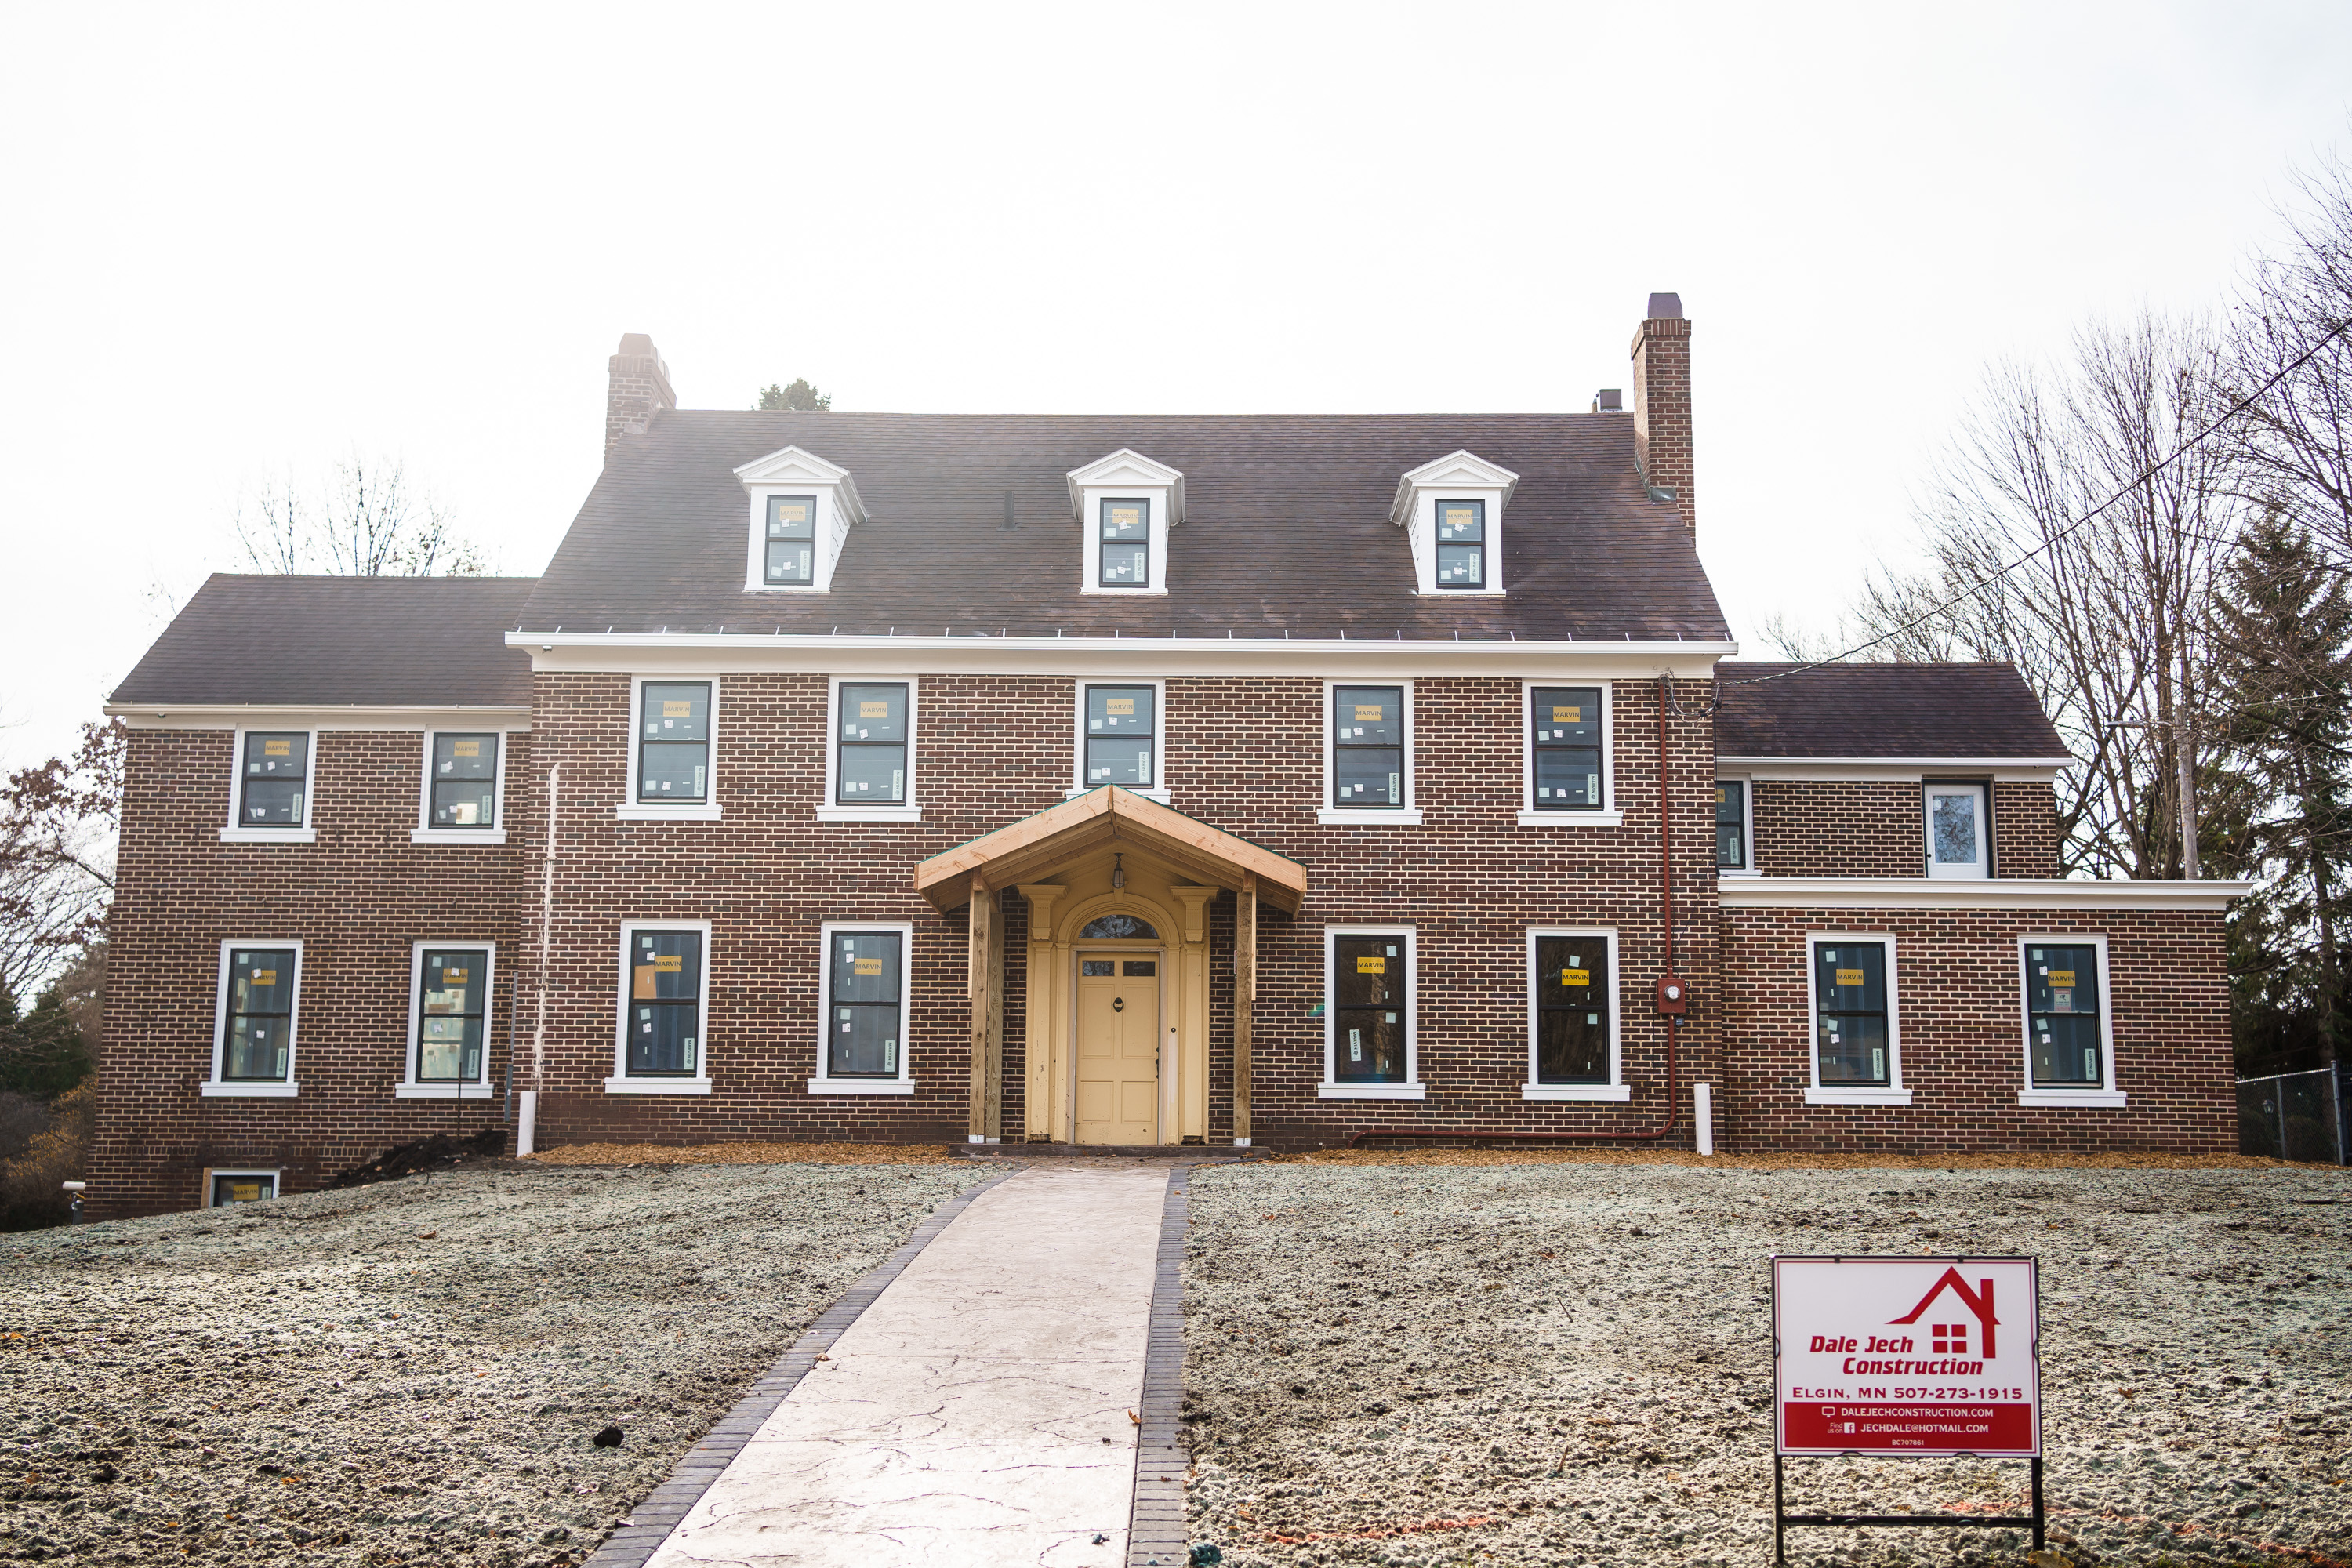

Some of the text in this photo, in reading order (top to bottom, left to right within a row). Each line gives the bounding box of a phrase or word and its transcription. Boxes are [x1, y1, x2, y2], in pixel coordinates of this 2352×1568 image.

[1810, 1336, 1914, 1353] Dale Jech
[1843, 1358, 1983, 1375] Construction
[1858, 1388, 1886, 1399] MN
[1894, 1388, 2022, 1399] 507-273-1915
[1841, 1408, 1993, 1417] DALEJECHCONSTRUCTION.COM
[1860, 1424, 1988, 1433] JECHDALE@HOTMAIL.COM
